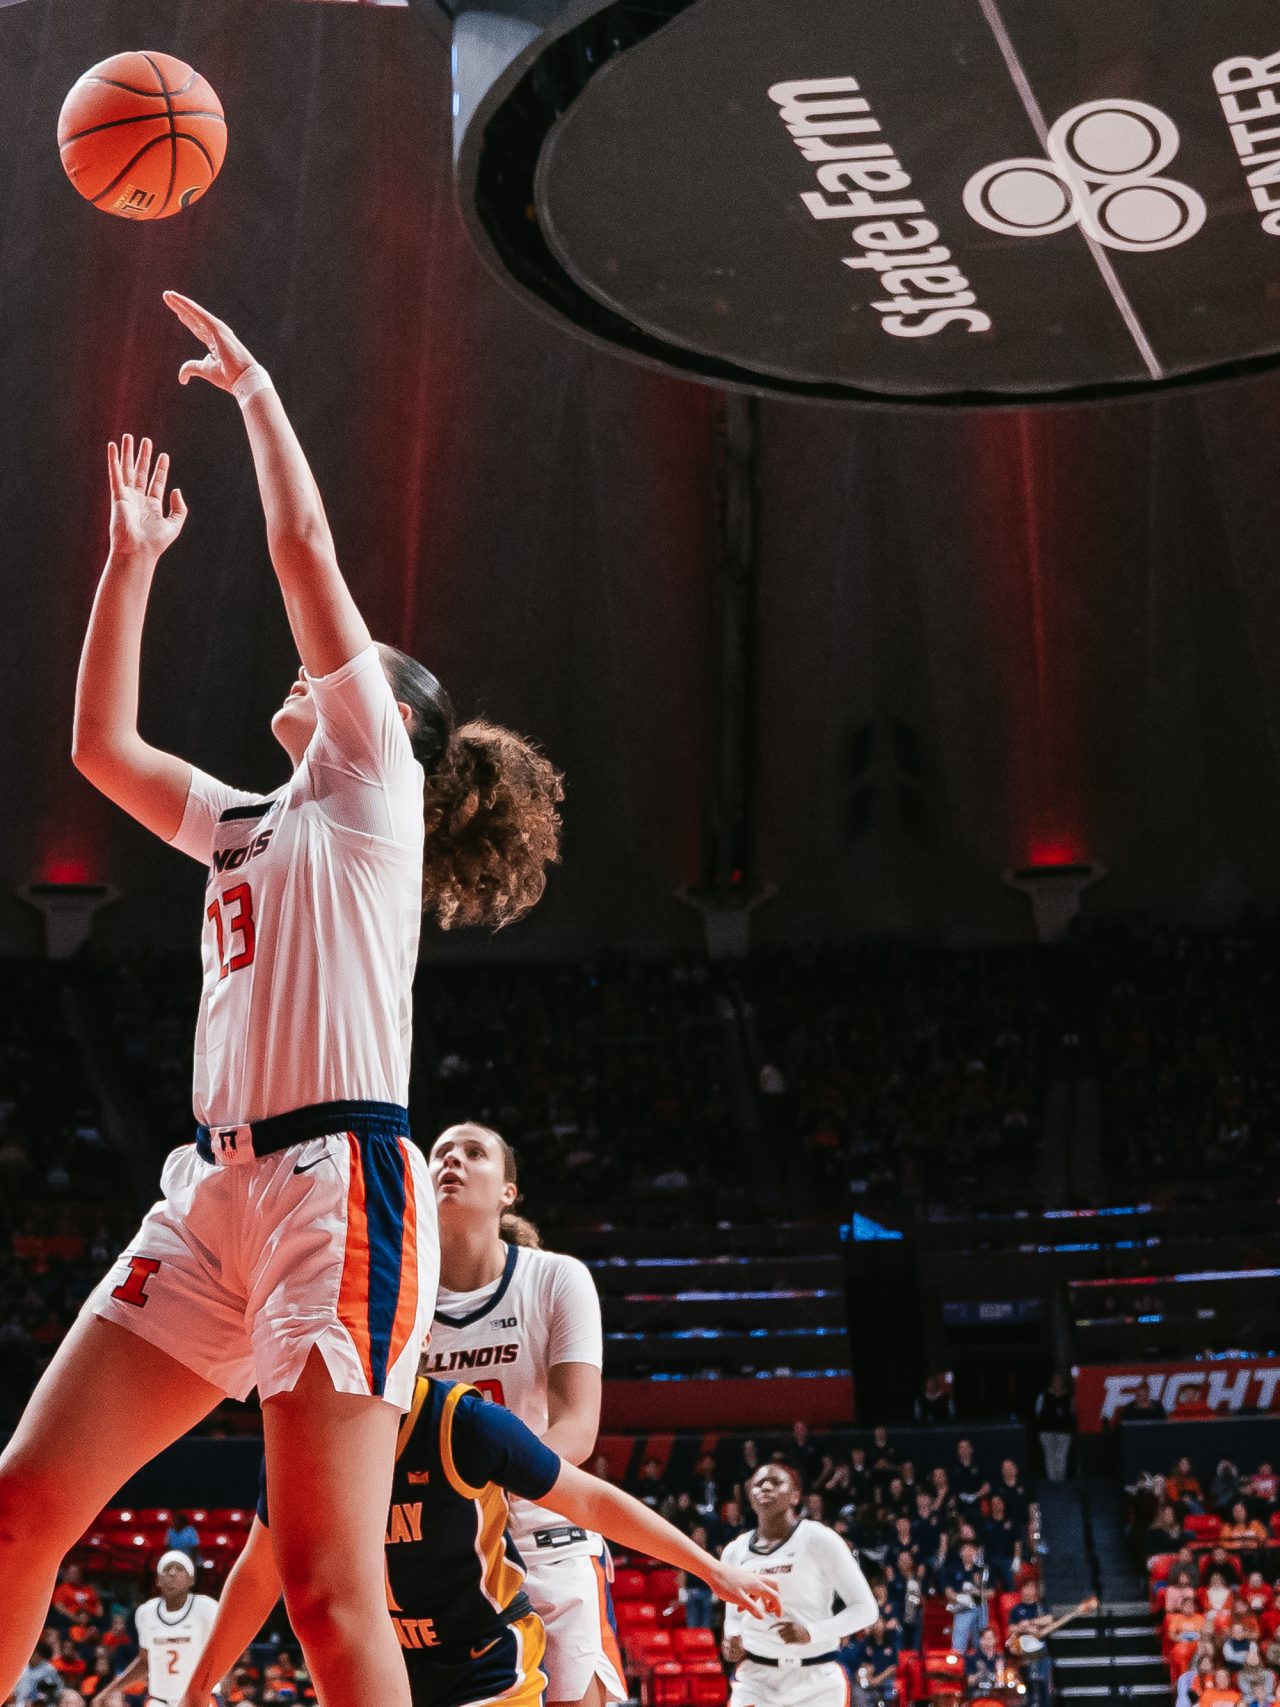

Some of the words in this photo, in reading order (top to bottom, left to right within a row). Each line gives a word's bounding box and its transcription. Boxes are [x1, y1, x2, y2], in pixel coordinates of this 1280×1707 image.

[212, 829, 274, 874] NOIS
[207, 882, 256, 981] 13
[418, 1343, 519, 1374] LLINOIS
[384, 1502, 423, 1544] AY
[166, 1648, 180, 1675] 2
